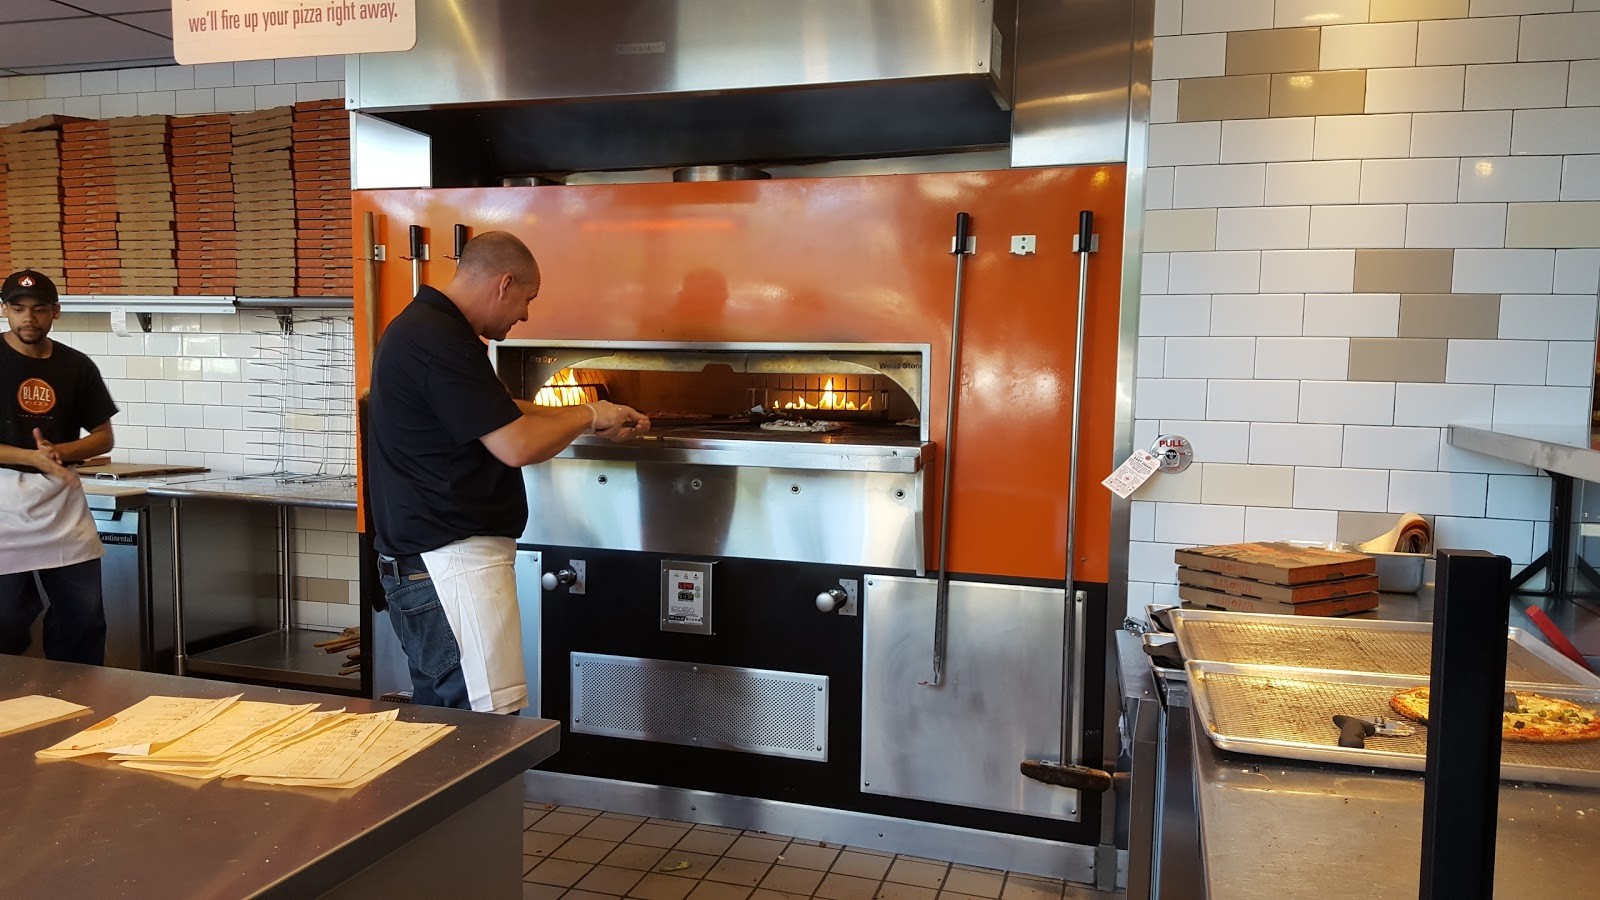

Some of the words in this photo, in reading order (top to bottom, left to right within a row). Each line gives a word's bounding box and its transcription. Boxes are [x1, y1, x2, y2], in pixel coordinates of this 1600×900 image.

[188, 10, 217, 32] we'll
[221, 9, 240, 30] fire
[244, 12, 258, 32] up
[262, 10, 289, 31] your
[293, 3, 322, 29] pizza
[326, 0, 356, 26] right
[359, 2, 398, 23] away.
[902, 361, 922, 369] Ston
[23, 385, 51, 402] BLAZE
[1159, 439, 1184, 448] PULL
[101, 533, 133, 543] ontinental
